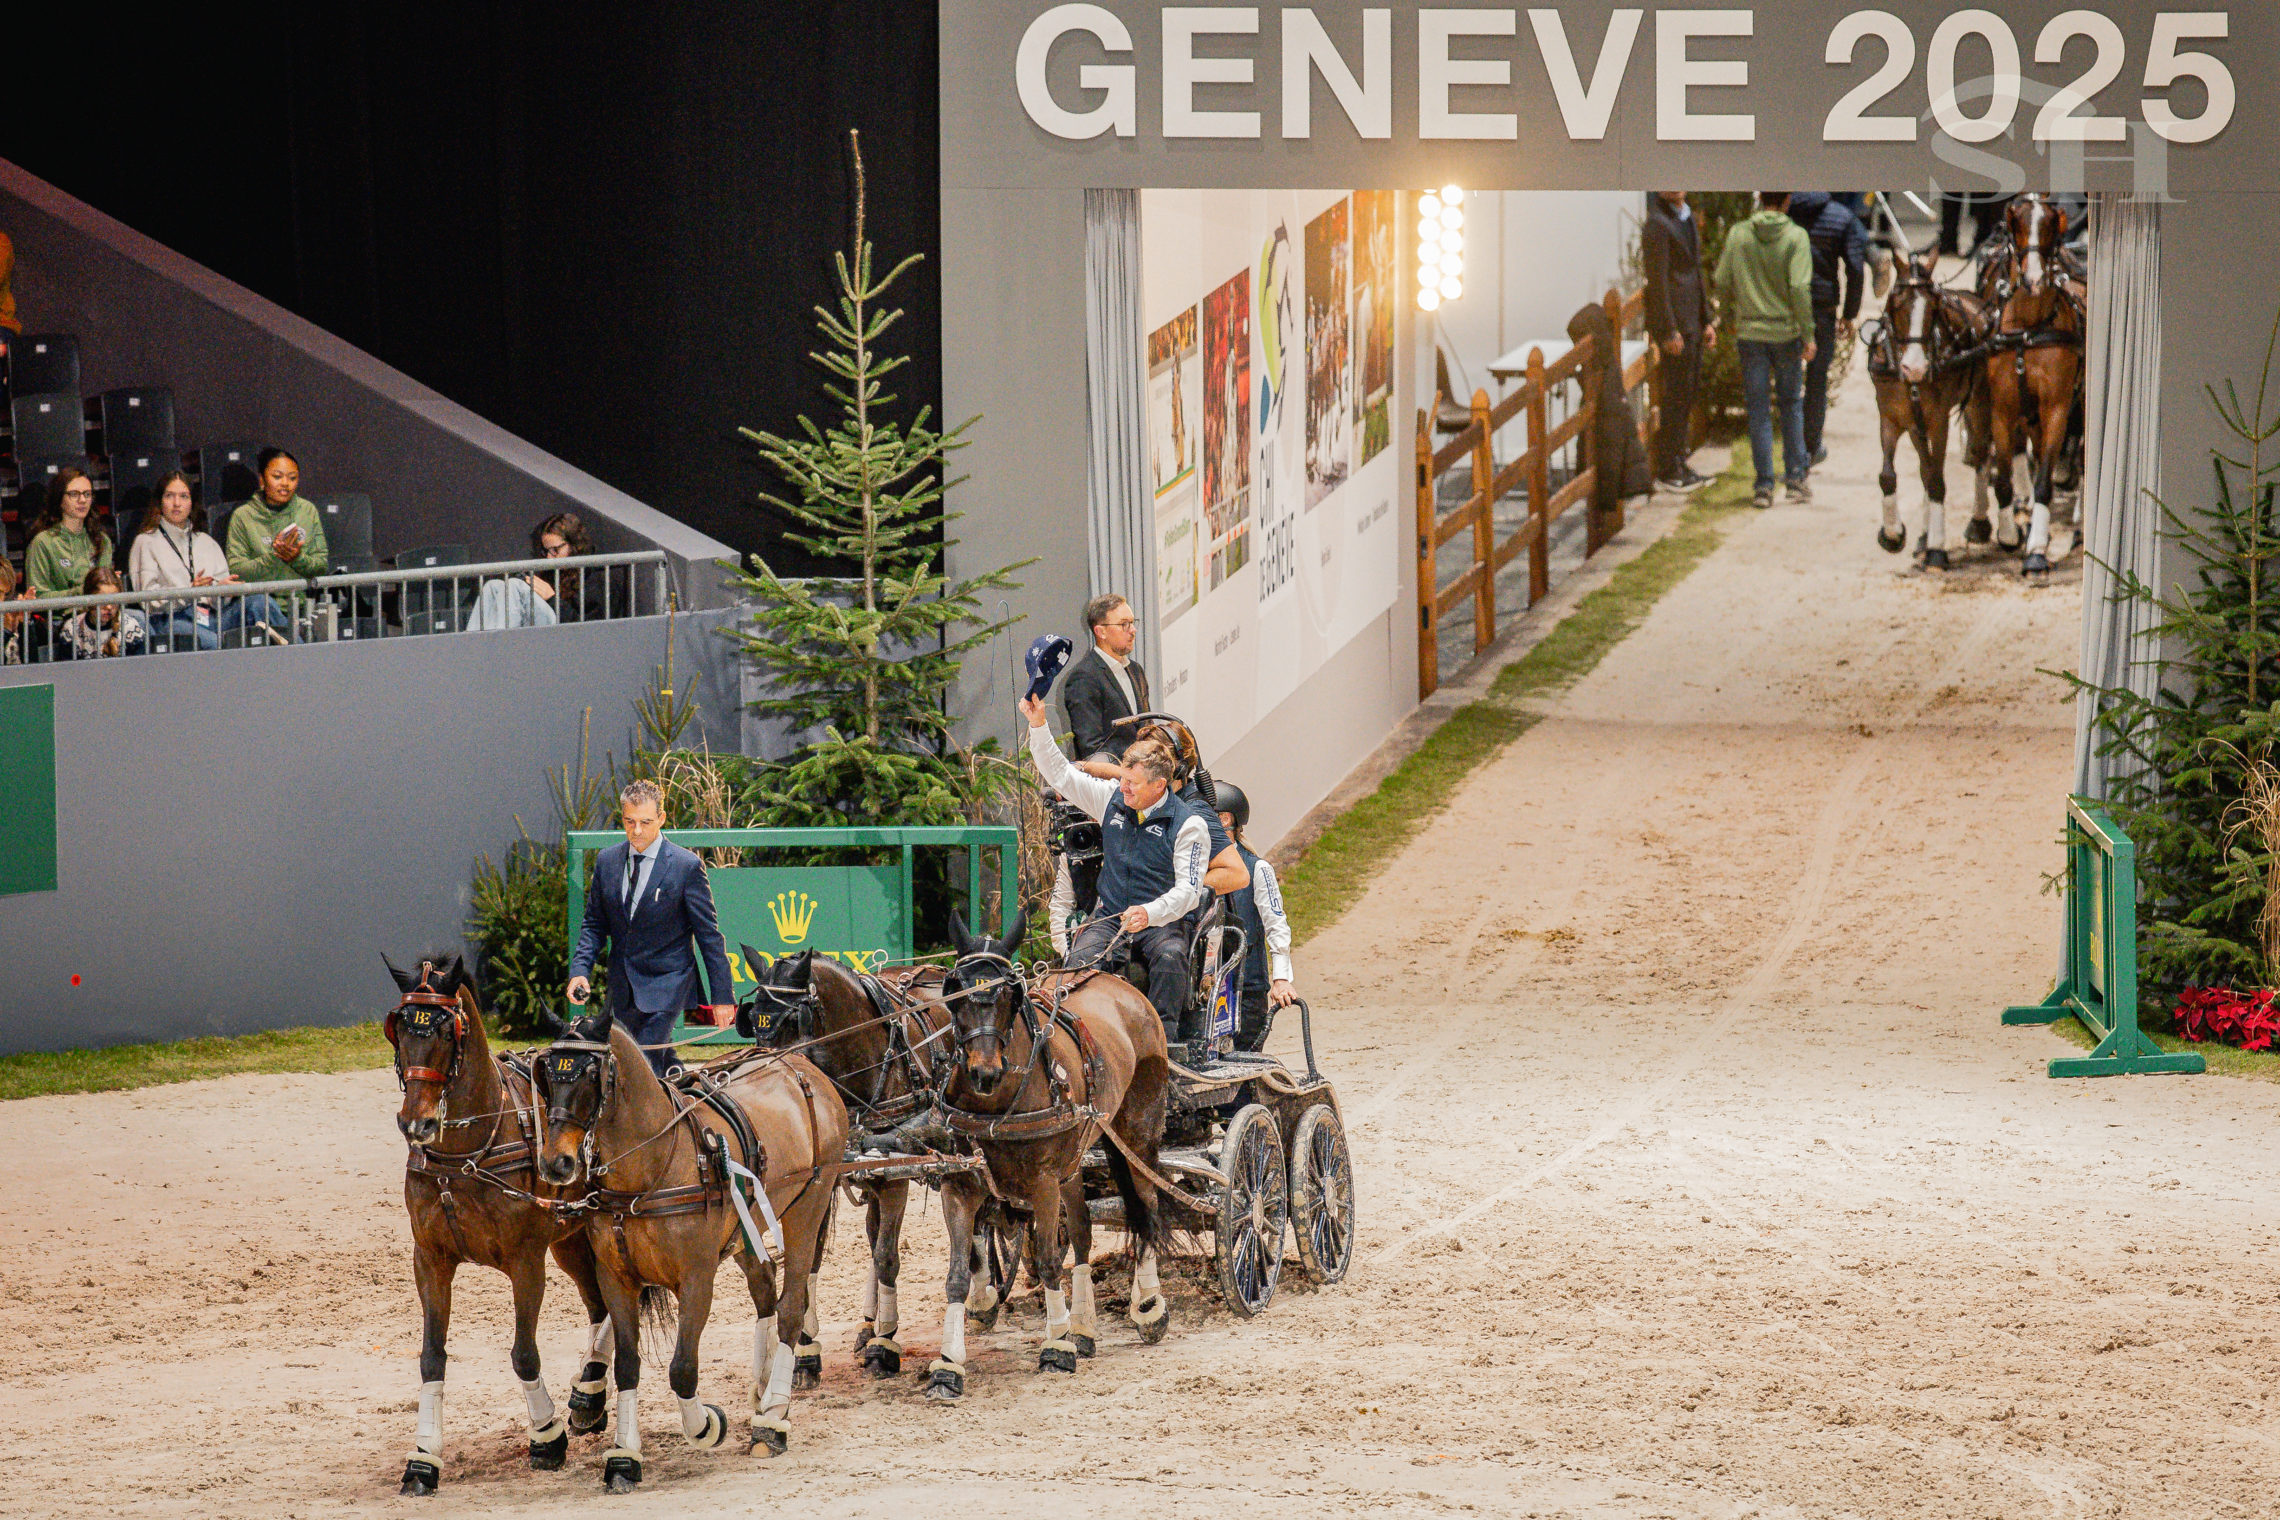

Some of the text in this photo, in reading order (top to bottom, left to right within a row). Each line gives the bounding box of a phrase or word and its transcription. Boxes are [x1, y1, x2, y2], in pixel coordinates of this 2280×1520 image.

[1016, 3, 2236, 143] GENEVE 2025
[727, 951, 874, 983] ROX
